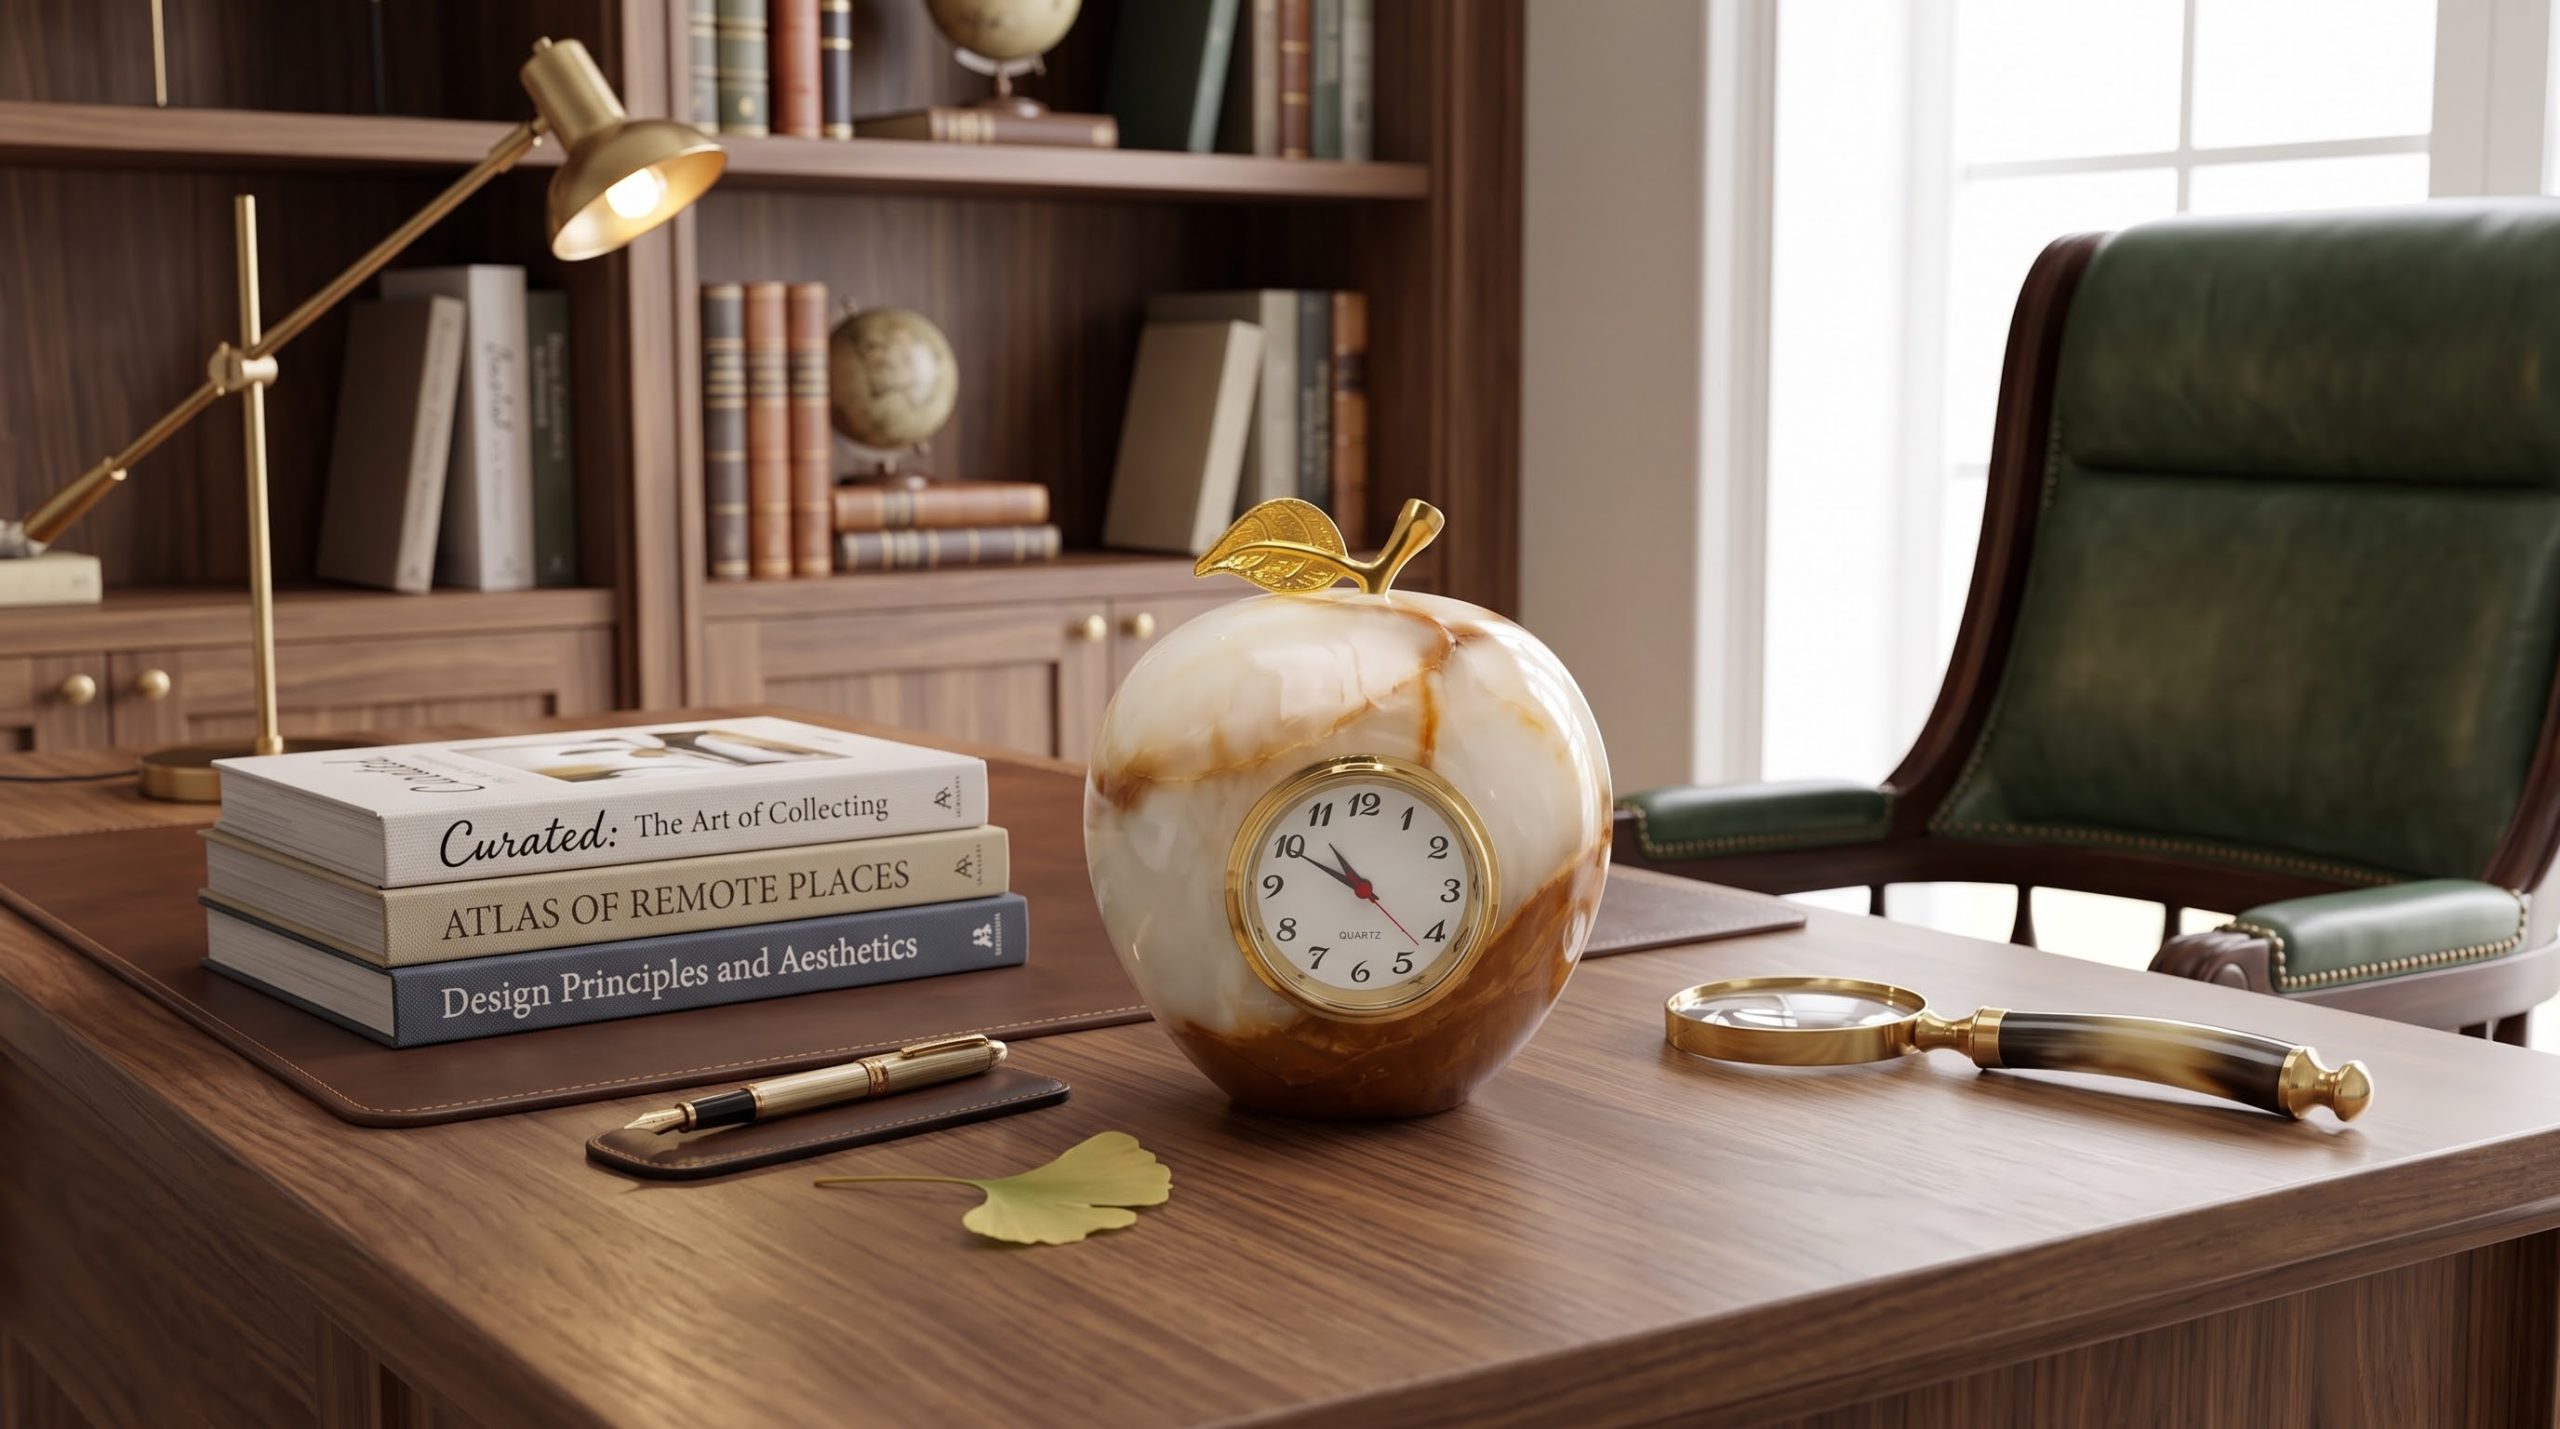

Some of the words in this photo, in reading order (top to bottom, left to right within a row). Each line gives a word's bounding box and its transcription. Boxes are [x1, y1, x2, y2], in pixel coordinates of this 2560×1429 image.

[1308, 802, 1333, 827] 11
[1347, 792, 1381, 817] 12
[1400, 806, 1415, 831] 1
[440, 809, 617, 868] Curated:
[634, 812, 683, 838] The
[691, 809, 730, 833] Art
[738, 801, 764, 827] of
[769, 795, 889, 824] Collecting
[1274, 834, 1305, 859] 10
[1426, 835, 1449, 859] 2
[1262, 874, 1284, 899] 9
[1440, 878, 1461, 903] 3
[441, 897, 560, 941] ATLAS
[571, 891, 619, 925] OF
[630, 874, 778, 919] REMOTE
[788, 859, 910, 901] PLACES
[1276, 917, 1297, 942] 8
[1338, 930, 1382, 940] QUARTZ
[1422, 918, 1446, 943] 4
[1308, 945, 1331, 970] 7
[1391, 951, 1415, 975] 5
[441, 981, 551, 1019] Design
[560, 958, 709, 1003] Principles
[717, 946, 771, 983] and
[777, 933, 918, 975] Aesthetics
[1350, 960, 1371, 983] 6
